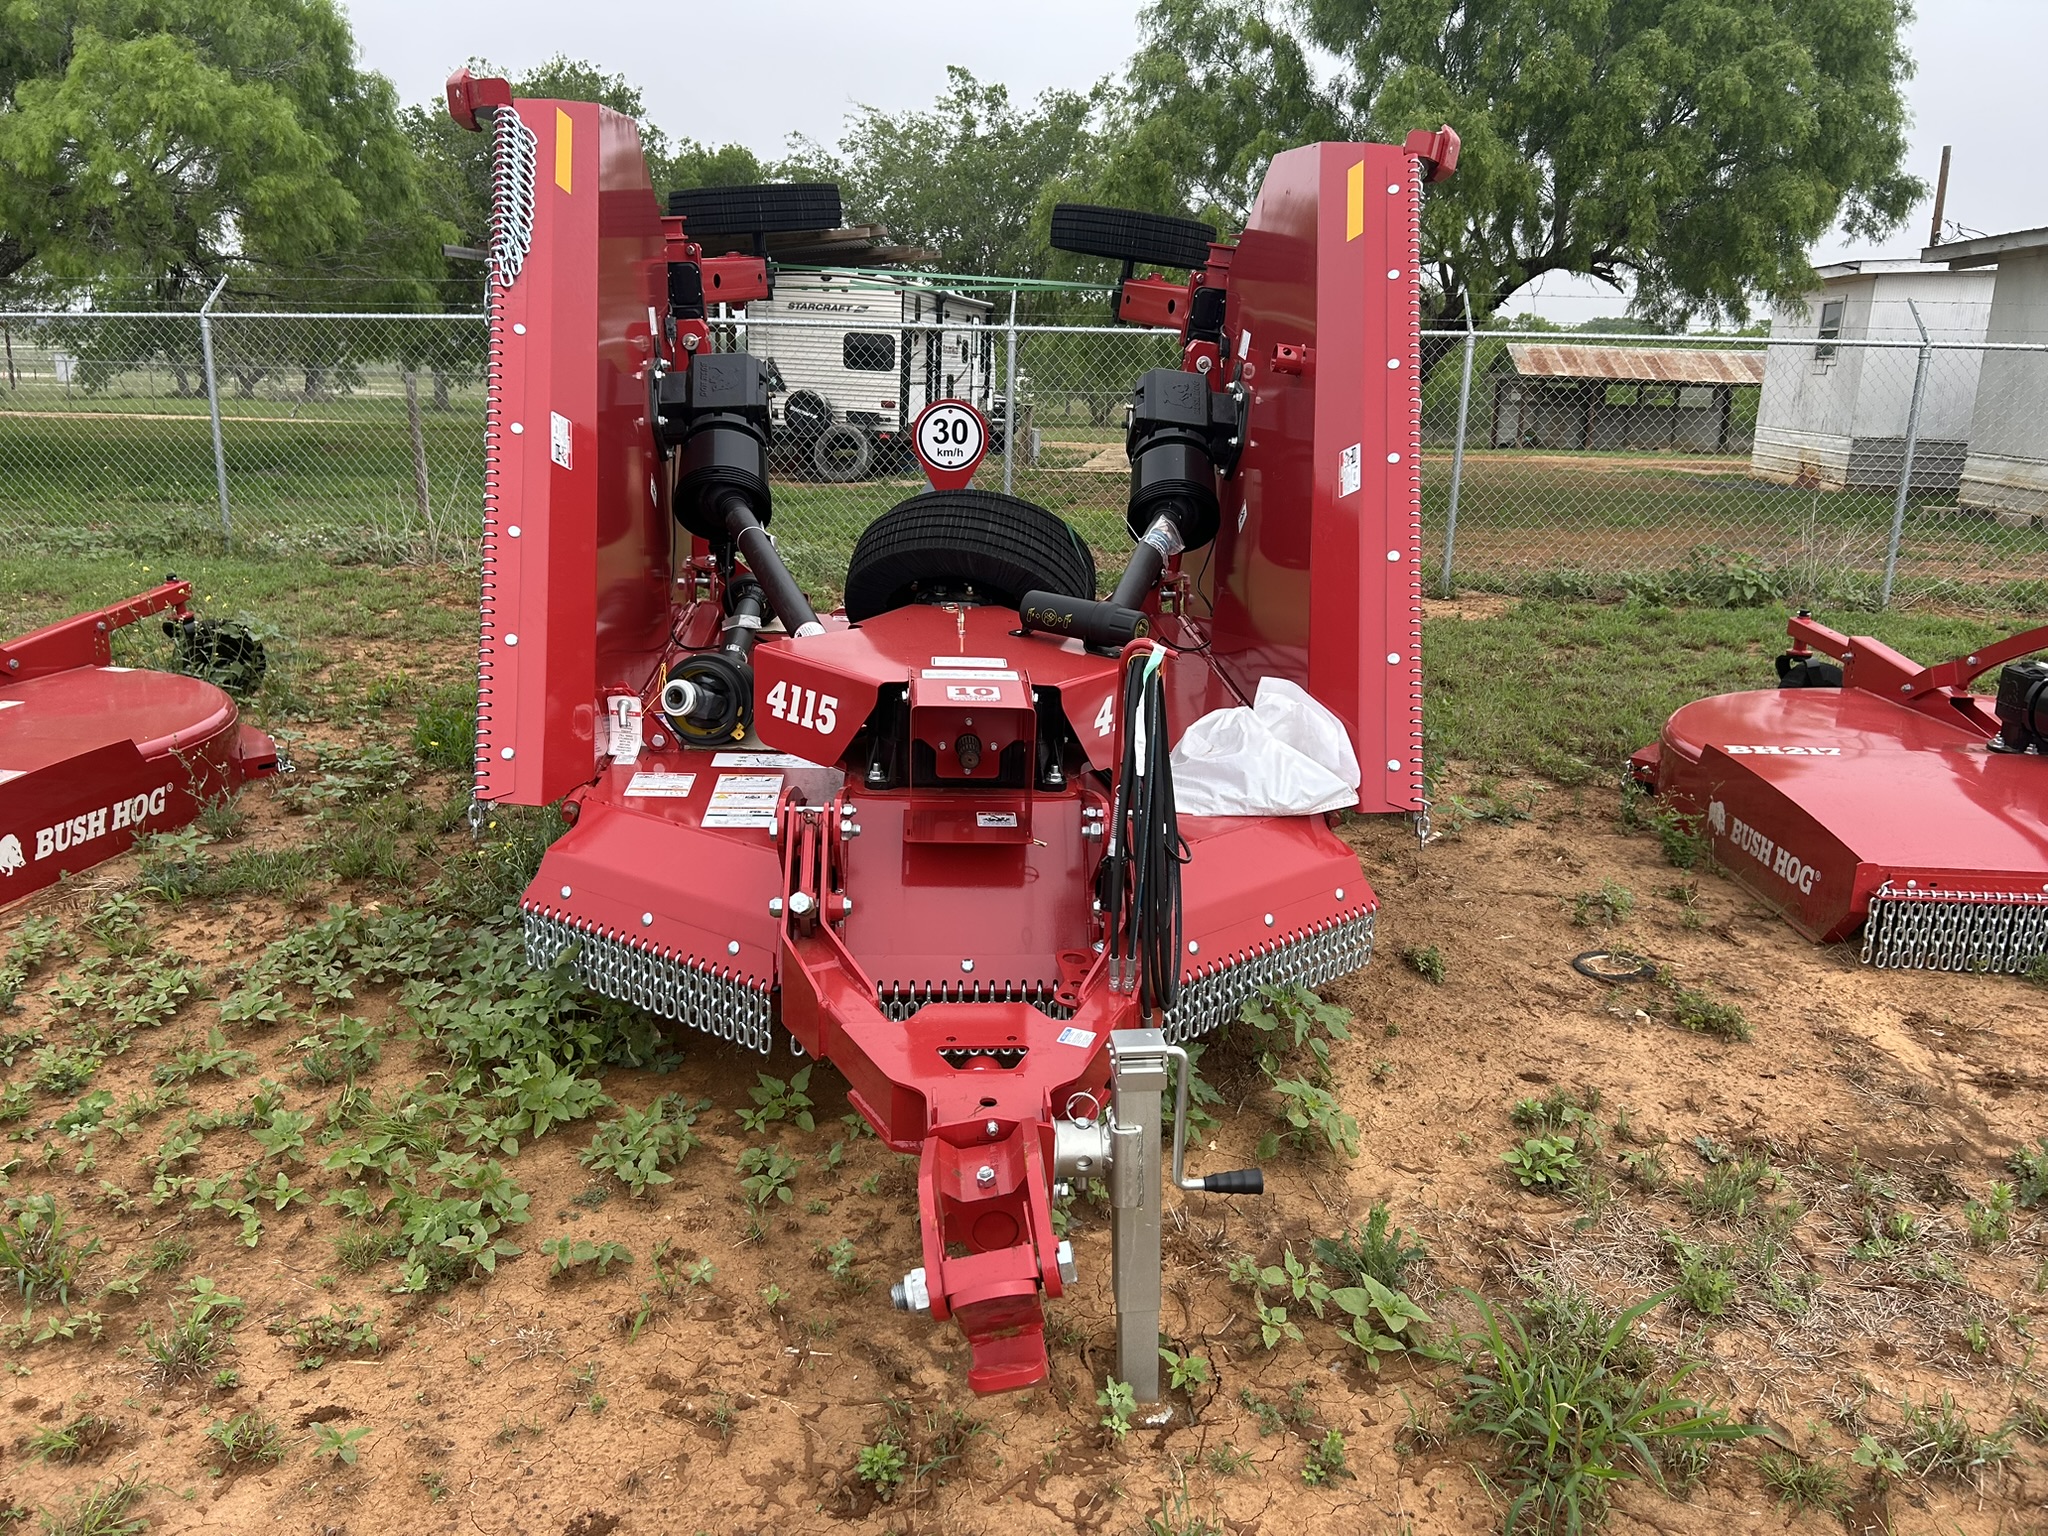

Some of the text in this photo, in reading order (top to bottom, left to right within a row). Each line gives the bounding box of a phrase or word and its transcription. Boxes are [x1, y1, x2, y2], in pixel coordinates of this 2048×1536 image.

[787, 302, 854, 313] STARCRAFT
[932, 418, 968, 445] 30
[936, 447, 964, 457] km/h
[954, 687, 994, 696] 10
[766, 680, 839, 735] 4115
[1723, 744, 1841, 756] BH217
[34, 807, 108, 861] BUSH
[1730, 817, 1775, 867] BUSH
